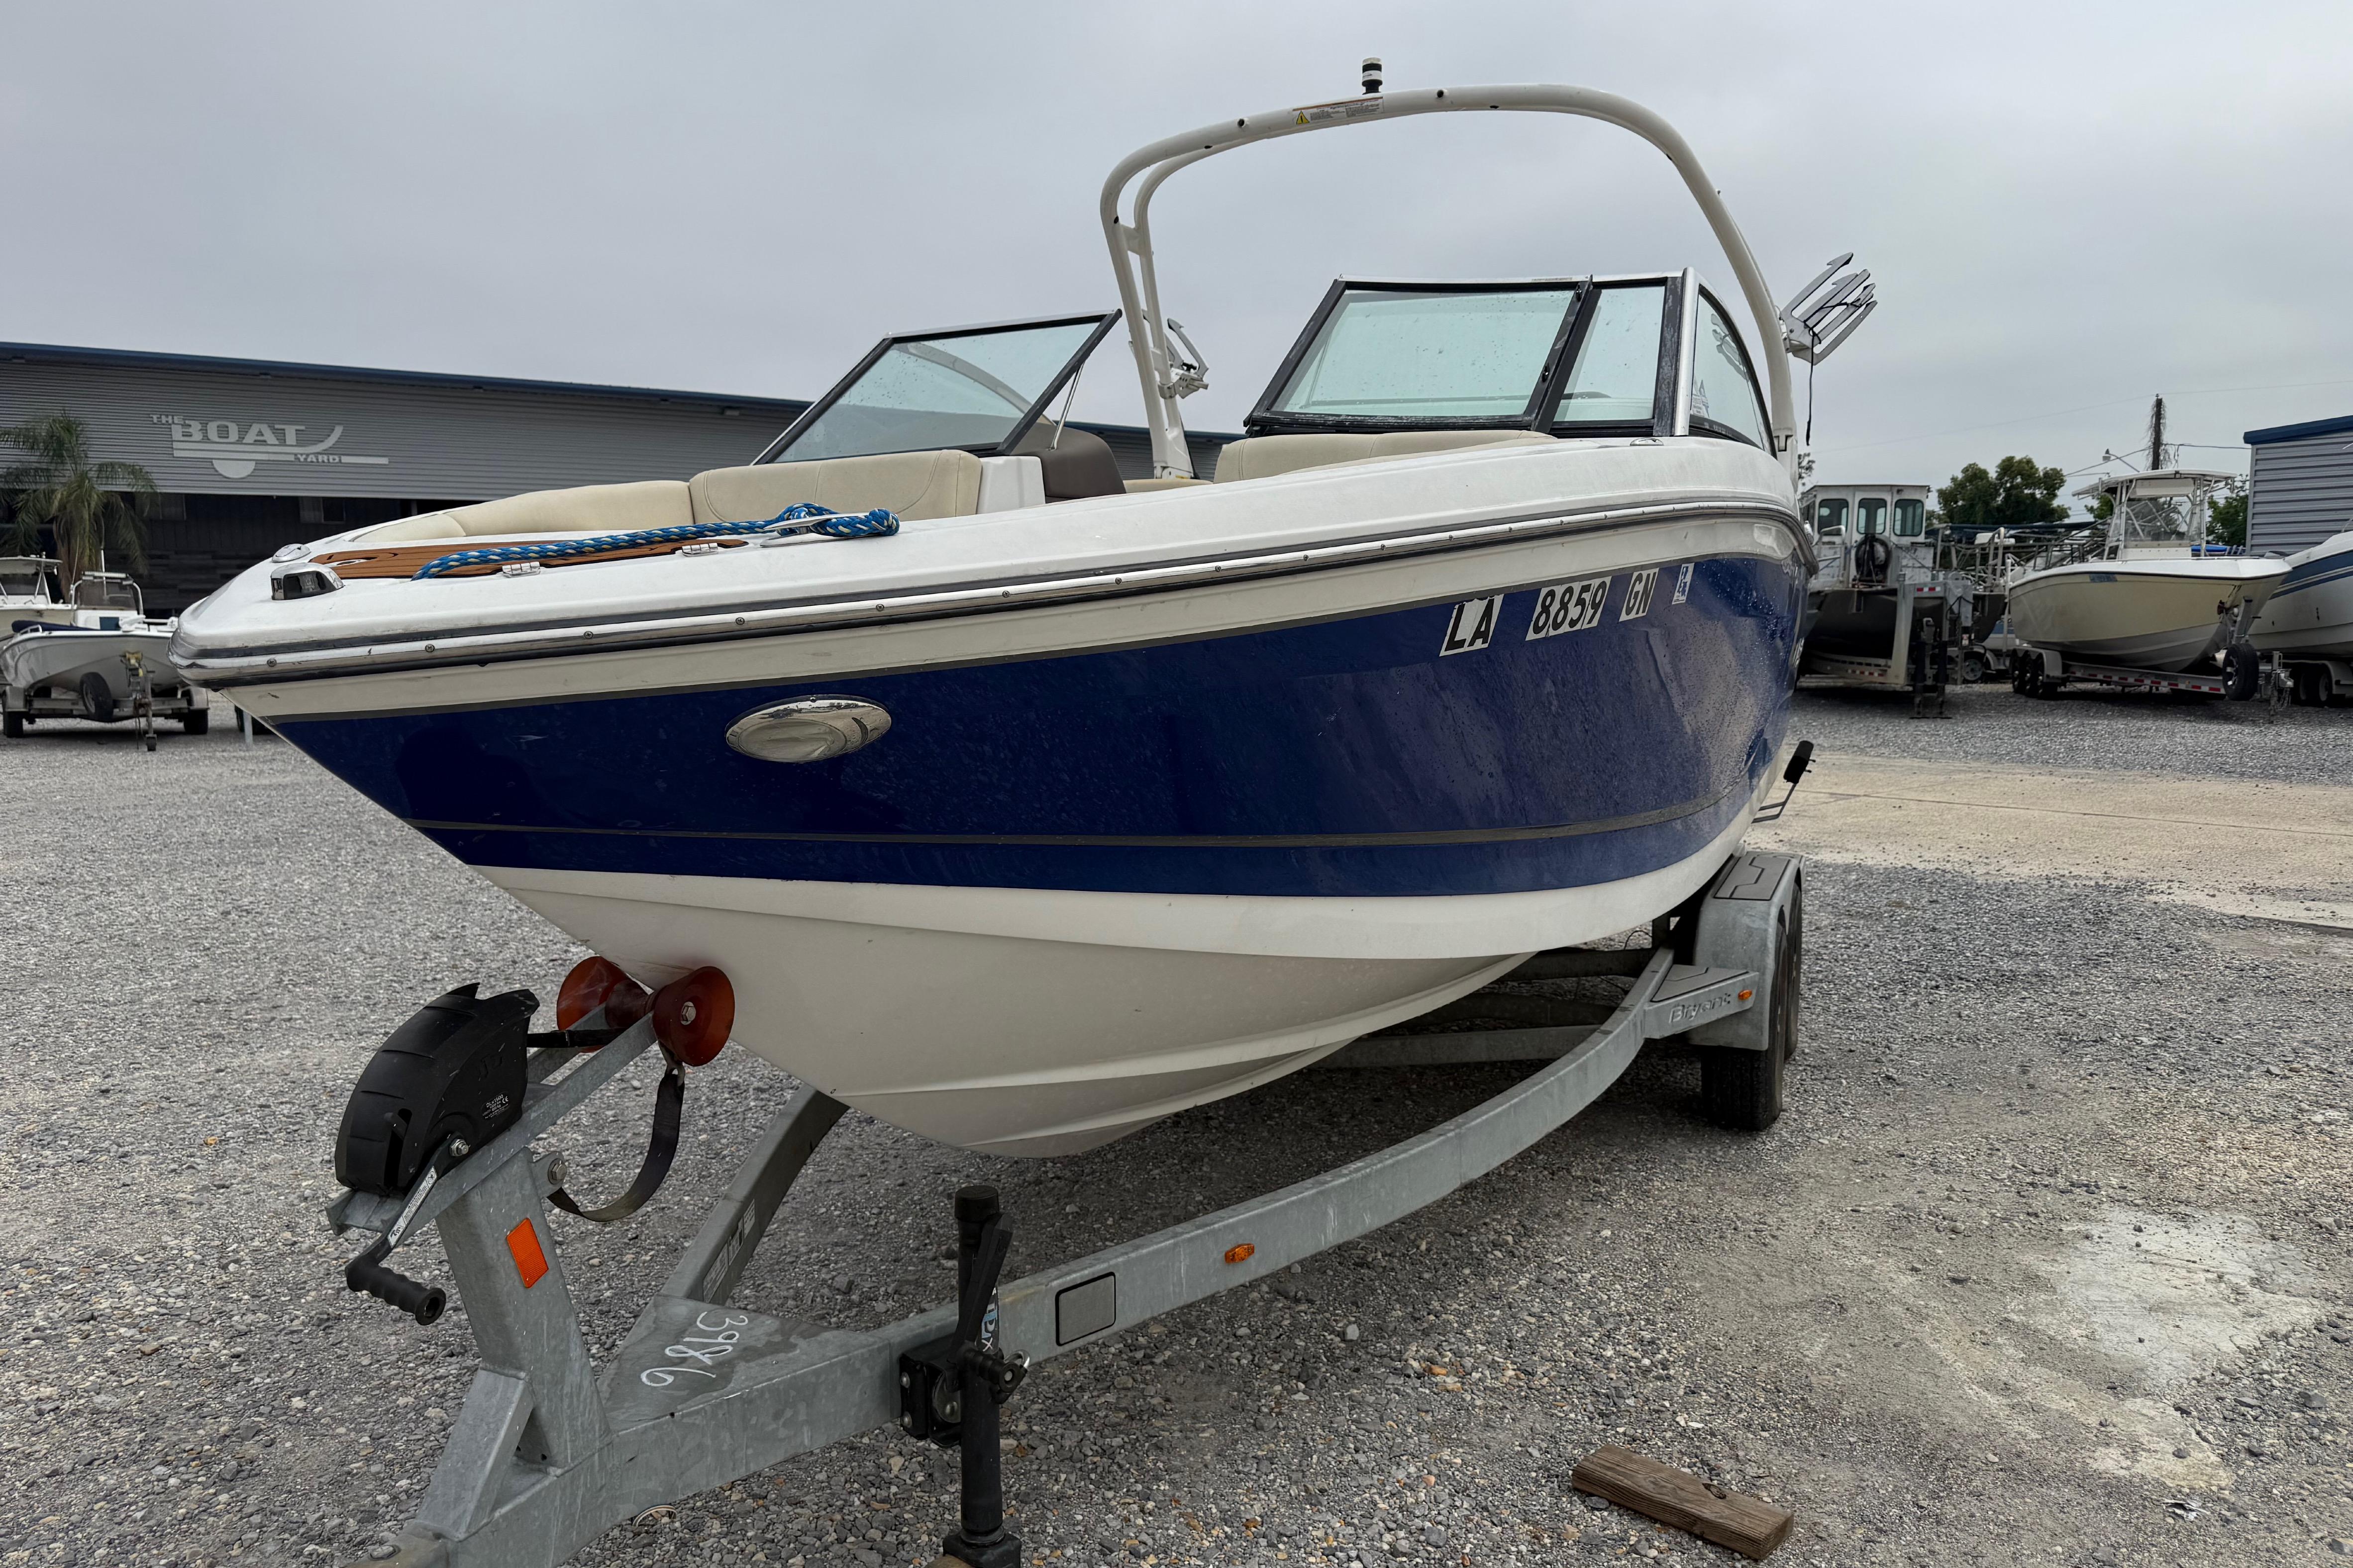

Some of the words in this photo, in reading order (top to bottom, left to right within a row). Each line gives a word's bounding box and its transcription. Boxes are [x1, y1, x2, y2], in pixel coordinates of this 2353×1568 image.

[150, 414, 185, 424] THE
[172, 420, 306, 445] BOAT
[297, 454, 339, 464] YARD
[1444, 597, 1496, 652] LA
[1533, 581, 1607, 635] 8859
[1626, 572, 1656, 616] GN
[1669, 993, 1731, 1024] Bryant
